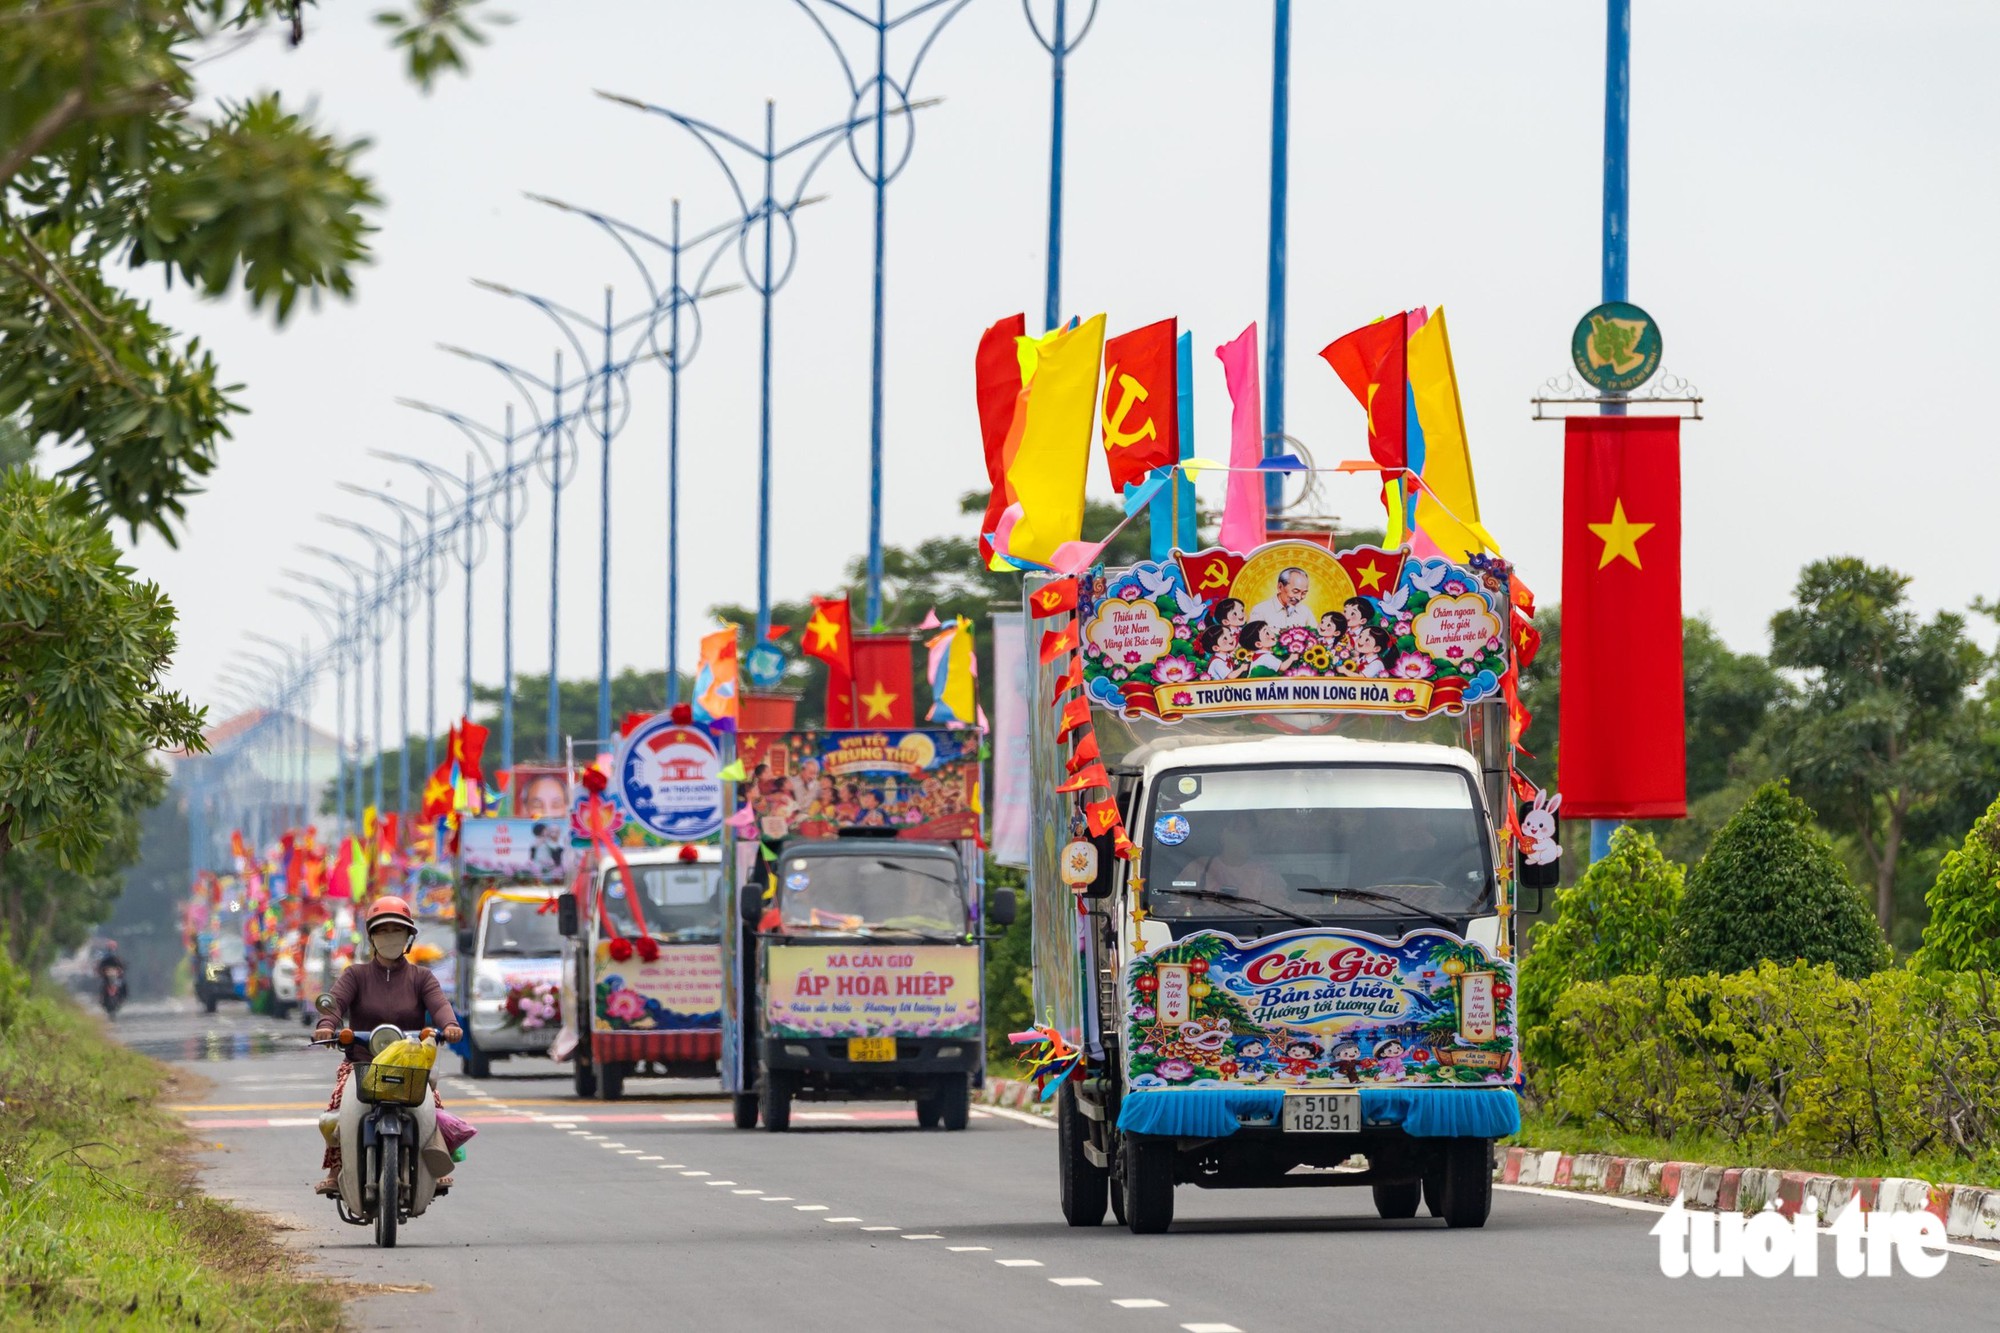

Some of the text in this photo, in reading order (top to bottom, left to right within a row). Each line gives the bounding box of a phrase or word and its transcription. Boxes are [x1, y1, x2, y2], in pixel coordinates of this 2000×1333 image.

[1113, 609, 1147, 622] Thiếu nhi
[1433, 607, 1476, 619] Chăm ngoan
[1113, 624, 1150, 636] Việt Nam
[1440, 620, 1455, 632] Học
[1134, 636, 1149, 647] Bác
[1150, 635, 1164, 647] dạy
[1426, 634, 1442, 645] Làm
[1463, 632, 1476, 643] việc
[1477, 627, 1488, 639] tốt
[1196, 682, 1390, 704] TRƯỜNG MẦM NON LONG HÒA
[827, 747, 883, 767] TRUNG
[1246, 947, 1398, 985] Cần Giờ
[794, 968, 831, 996] ẤP
[894, 970, 955, 1001] HIỆP
[1255, 981, 1395, 1007] Bản sắc biển
[1252, 999, 1401, 1024] Hướng tới tương lai
[1305, 1096, 1338, 1112] 51D
[1294, 1114, 1350, 1131] 182.91
